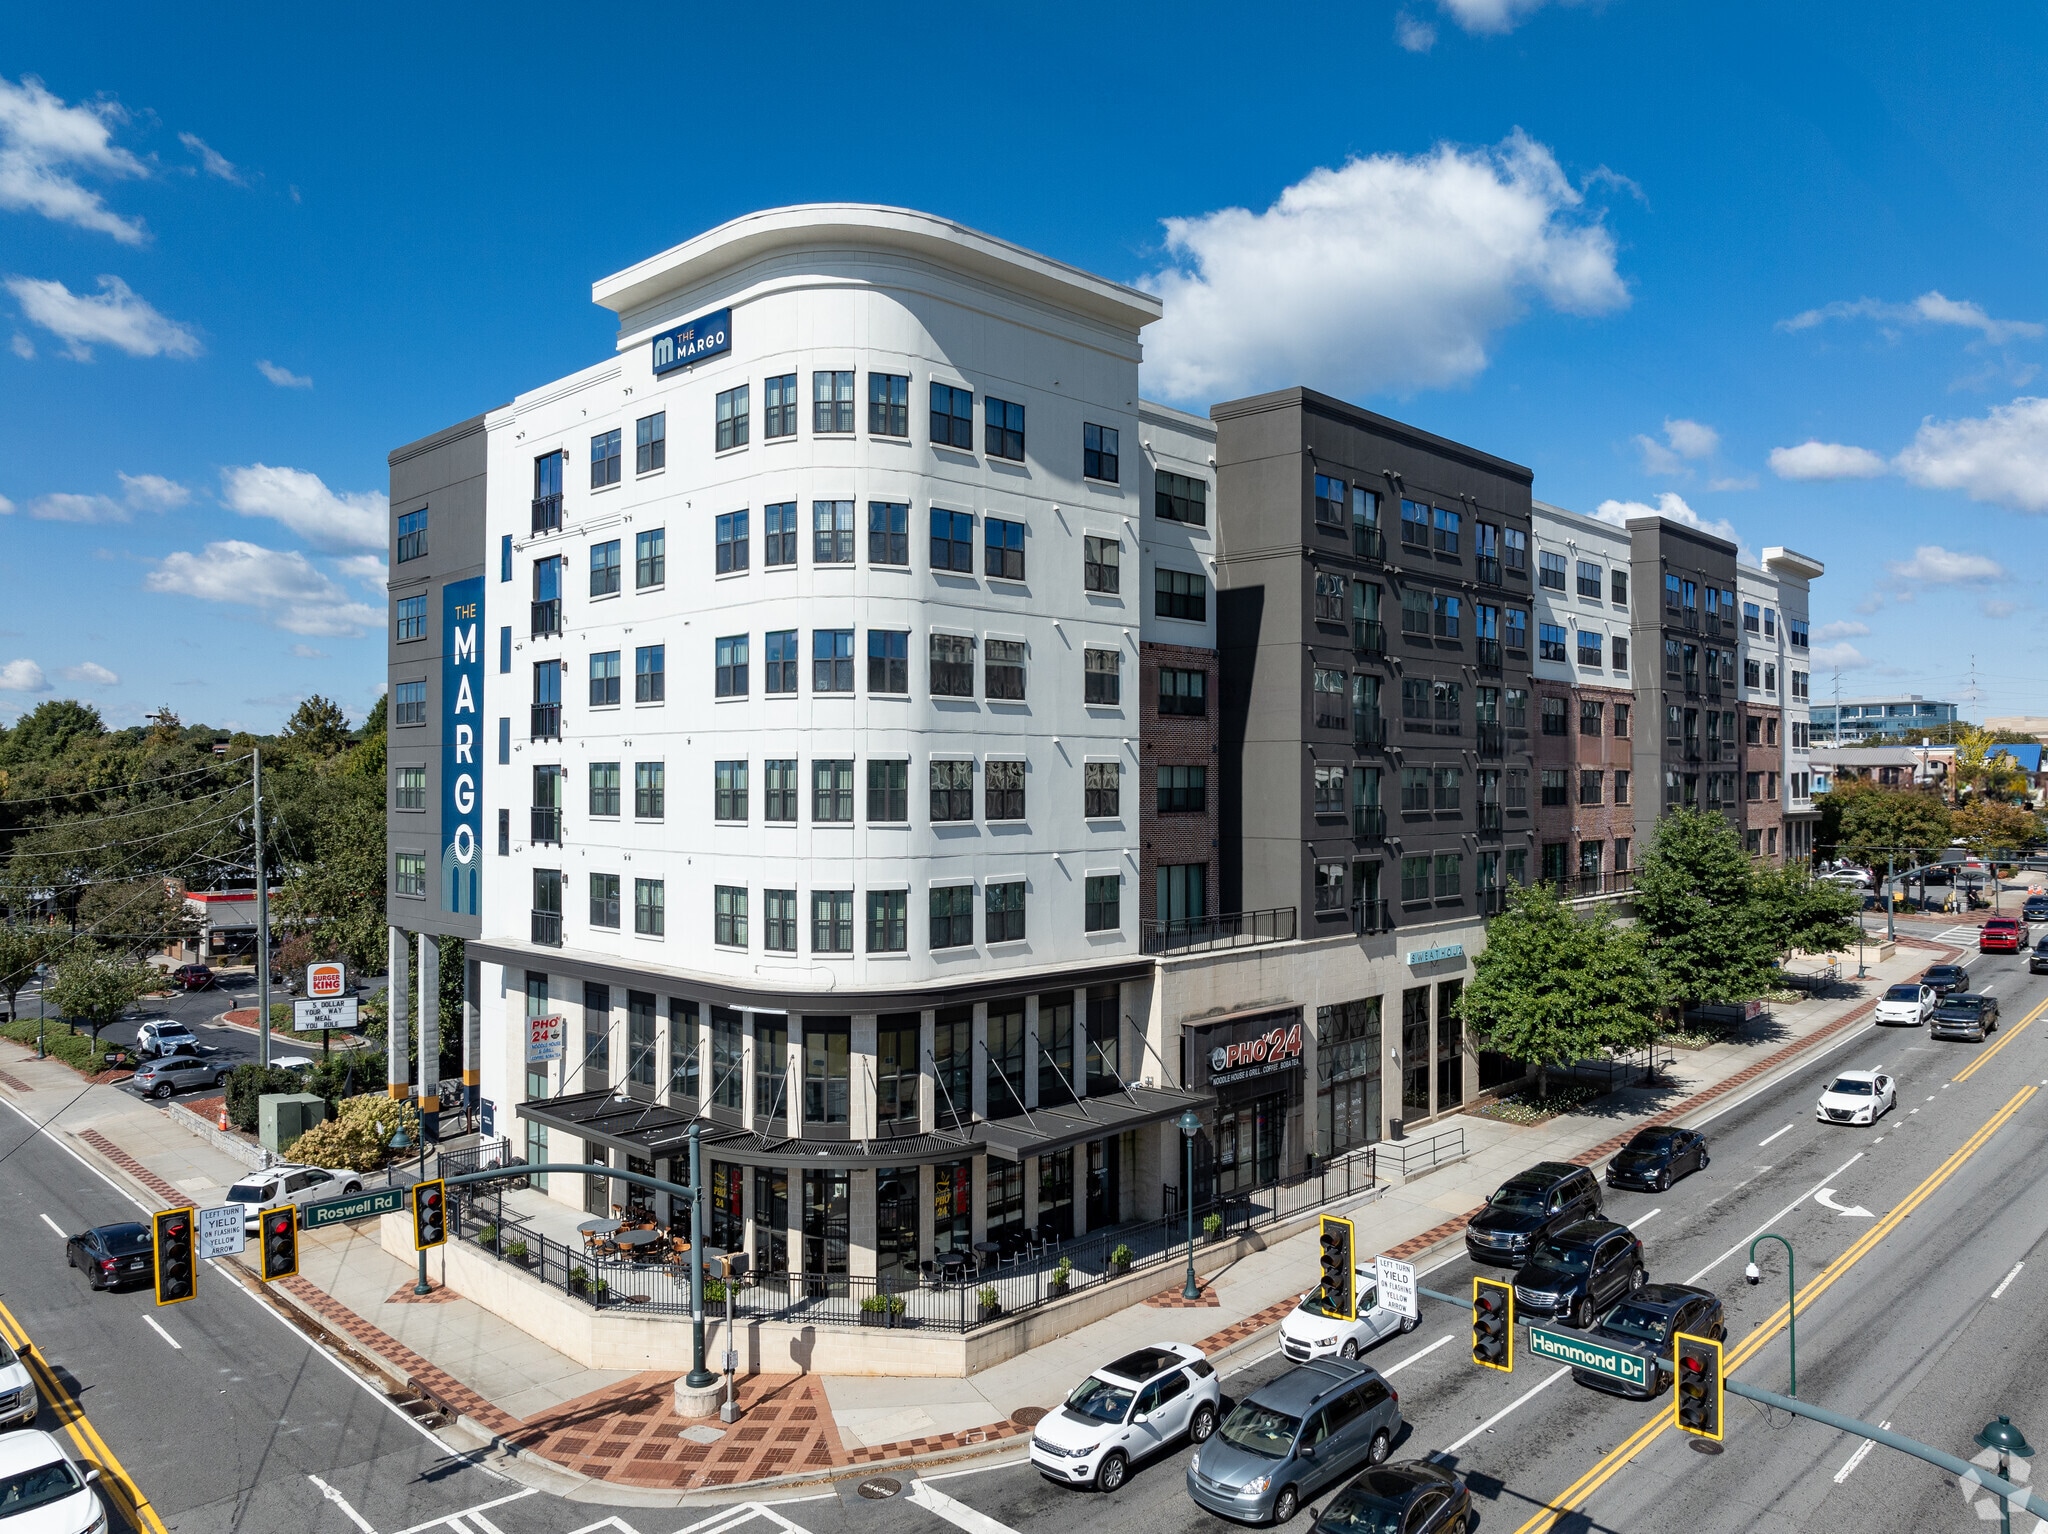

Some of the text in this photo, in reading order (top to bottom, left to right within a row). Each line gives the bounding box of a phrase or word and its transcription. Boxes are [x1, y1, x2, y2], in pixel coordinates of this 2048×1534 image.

[677, 329, 695, 344] THE
[677, 331, 725, 360] MARGO
[455, 603, 477, 620] THE
[454, 622, 477, 865] MARGO
[313, 974, 340, 982] BURGER
[313, 980, 340, 990] KING
[321, 1000, 345, 1008] DOLLAR
[305, 1007, 343, 1016] YOUR WAY
[531, 1030, 549, 1042] 24
[1268, 1024, 1302, 1063] 24
[1213, 1074, 1230, 1086] NOODLE
[1230, 1071, 1245, 1081] HOUSE
[1280, 1060, 1292, 1070] BOBA
[317, 1195, 393, 1222] Roswell Rd
[715, 1197, 724, 1208] 24
[205, 1207, 240, 1219] LEFT TURN
[937, 1206, 948, 1217] 24
[209, 1216, 237, 1229] YIELD
[204, 1226, 240, 1239] ON FLASHING
[210, 1236, 235, 1246] YELLOW
[211, 1245, 234, 1255] ARROW
[1380, 1259, 1411, 1273] LEFT TURN
[1383, 1269, 1409, 1284] YIELD
[1381, 1279, 1412, 1295] ON FLASHING
[1386, 1290, 1408, 1303] YELLOW
[1388, 1301, 1407, 1312] ARROW
[1532, 1333, 1642, 1378] Hammond Dr
